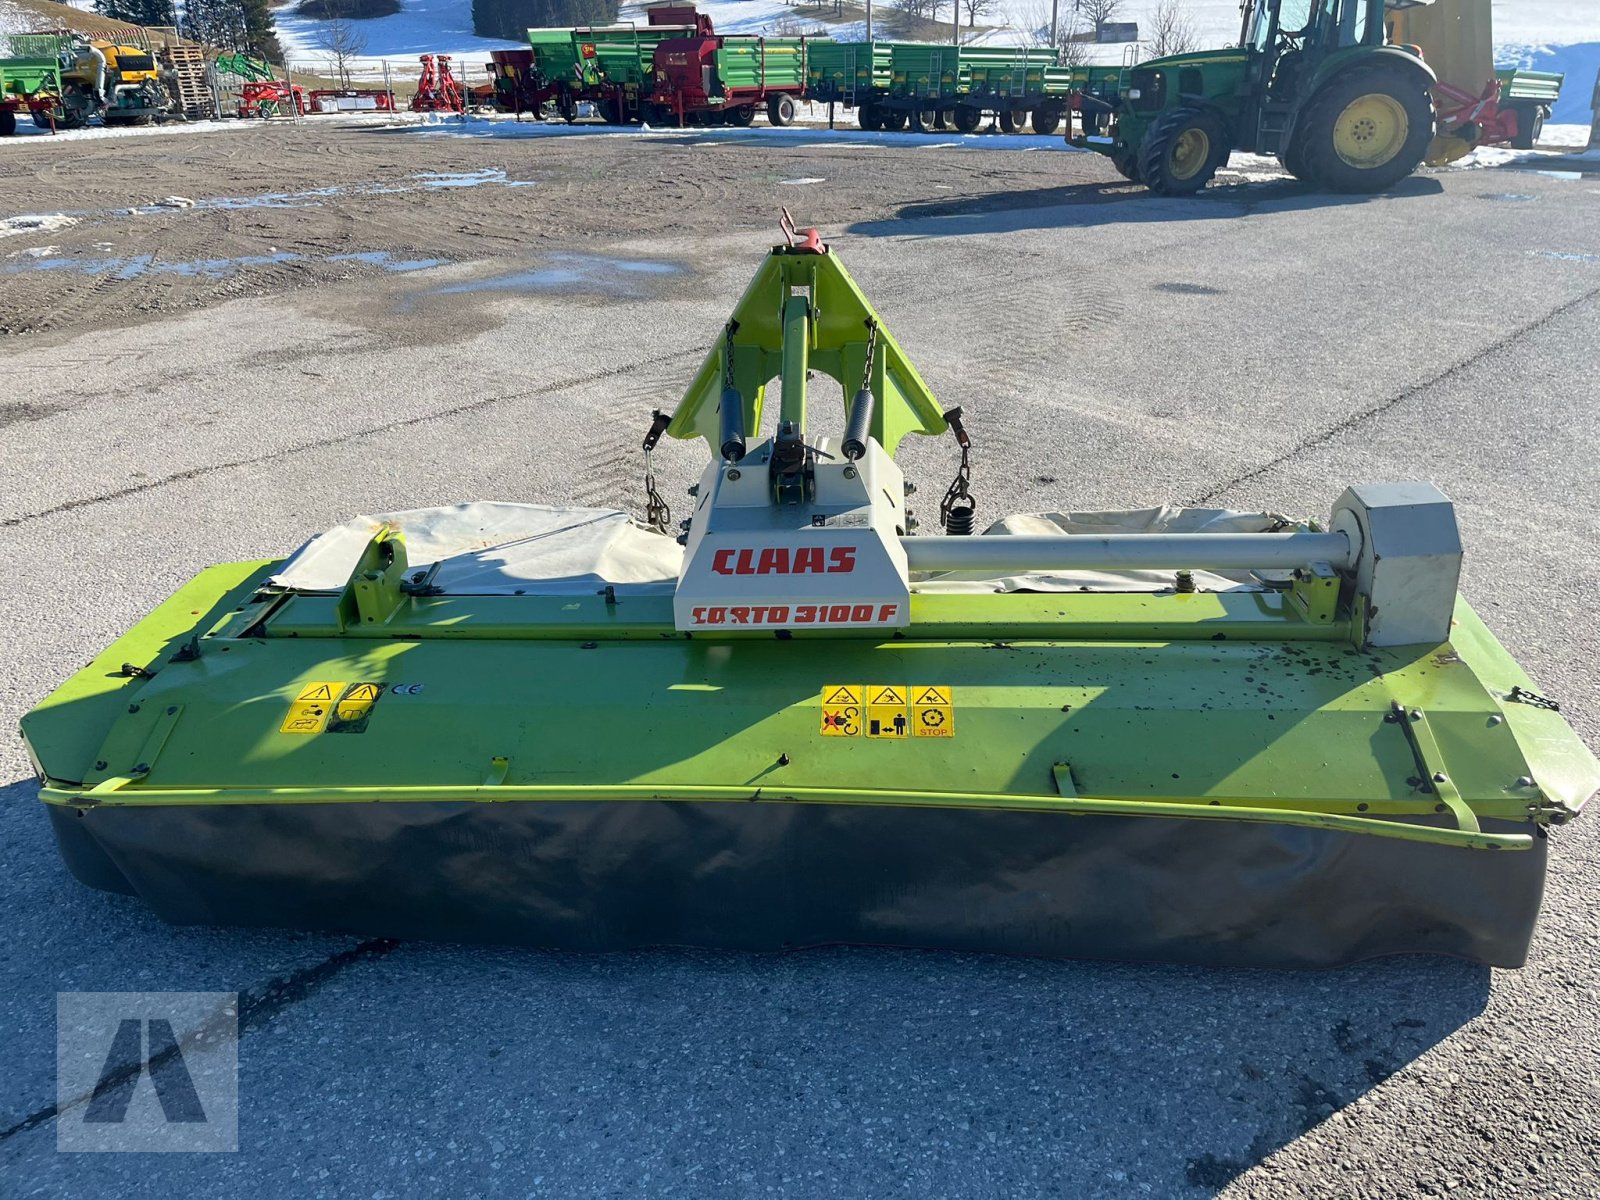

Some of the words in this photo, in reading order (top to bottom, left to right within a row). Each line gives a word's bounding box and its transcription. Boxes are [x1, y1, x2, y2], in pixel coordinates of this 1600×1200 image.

[711, 546, 857, 575] CLAAS
[691, 606, 790, 625] CORTO
[794, 604, 874, 623] 3100
[878, 604, 898, 622] F
[919, 728, 948, 736] STOP
